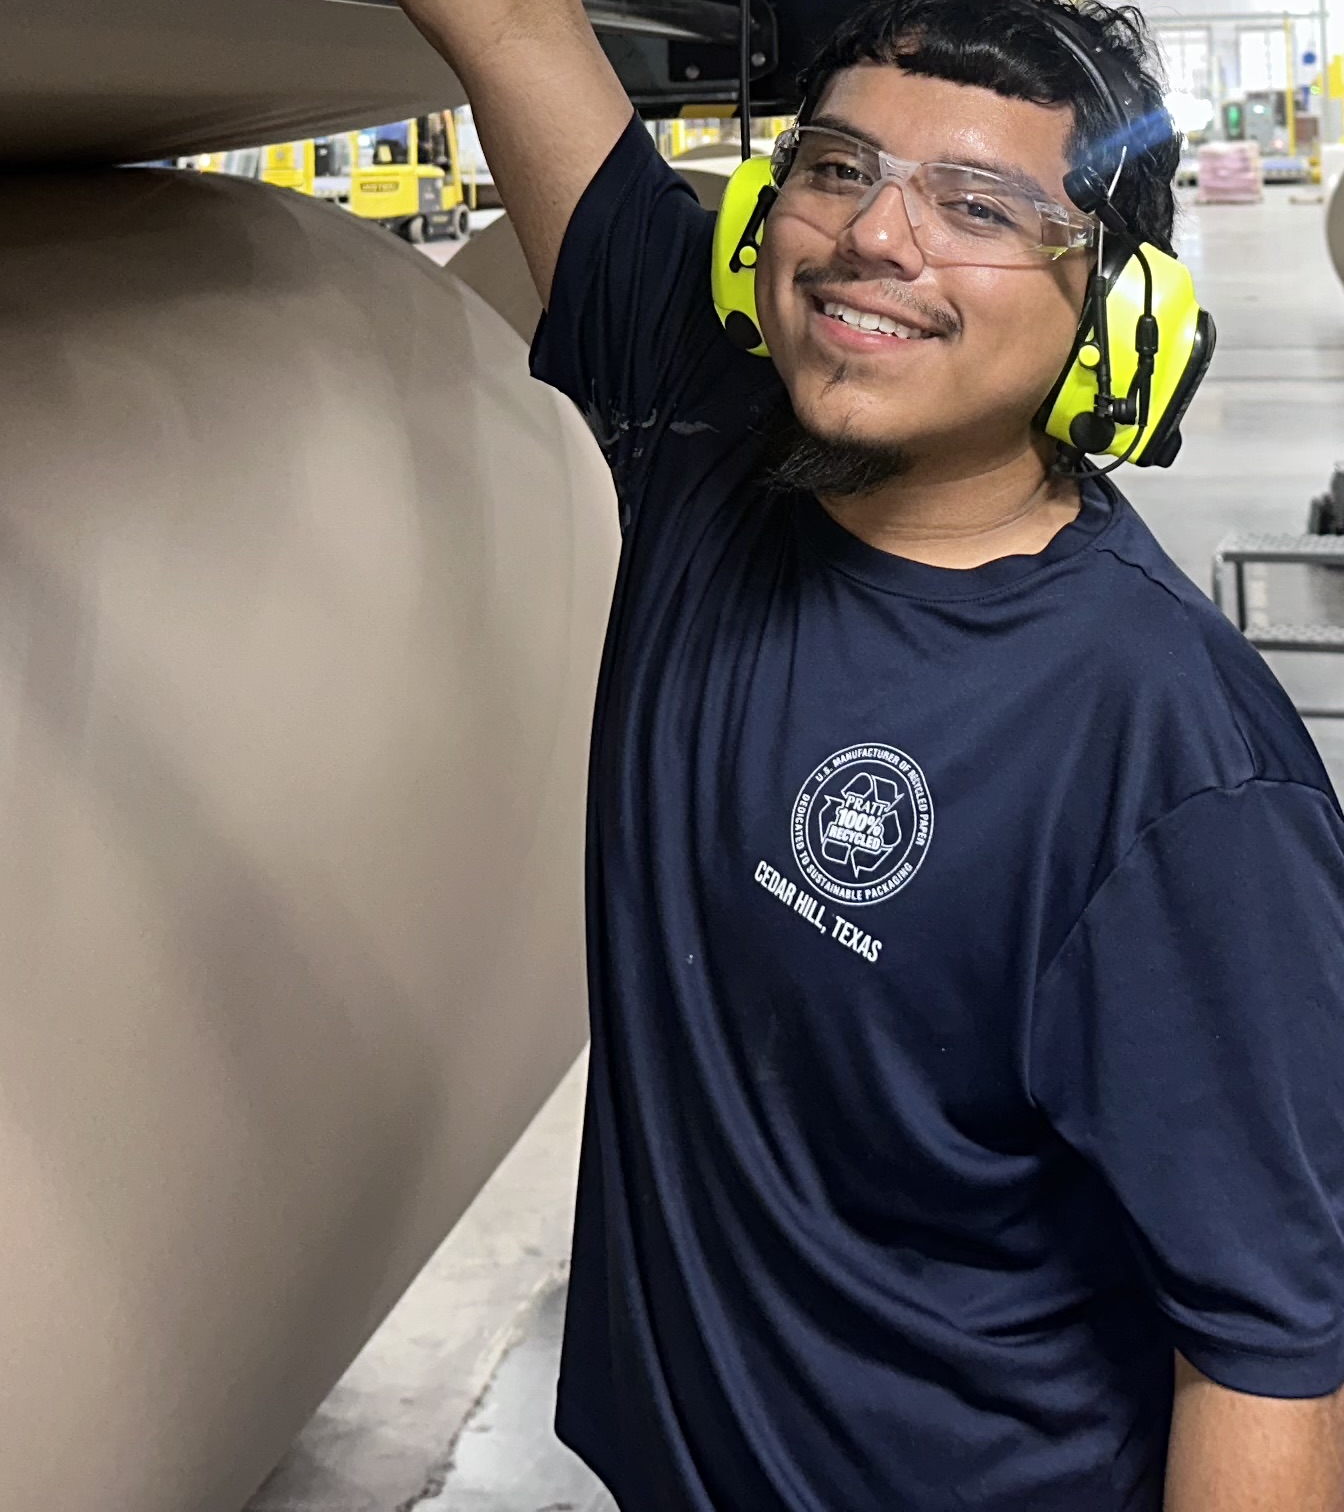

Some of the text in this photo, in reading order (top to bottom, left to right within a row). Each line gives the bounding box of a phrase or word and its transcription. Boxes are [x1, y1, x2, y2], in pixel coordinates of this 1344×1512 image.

[815, 748, 929, 846] U.S. MANUFACTURER OF RECYCLED PAPER
[838, 808, 881, 836] 100%
[845, 795, 886, 816] PRATT
[795, 793, 913, 900] DEDICATED TO SUSTAINABLE PACKAGING
[829, 824, 881, 850] RECYCLED
[754, 860, 882, 962] CEDAR HILL, TEXAS
